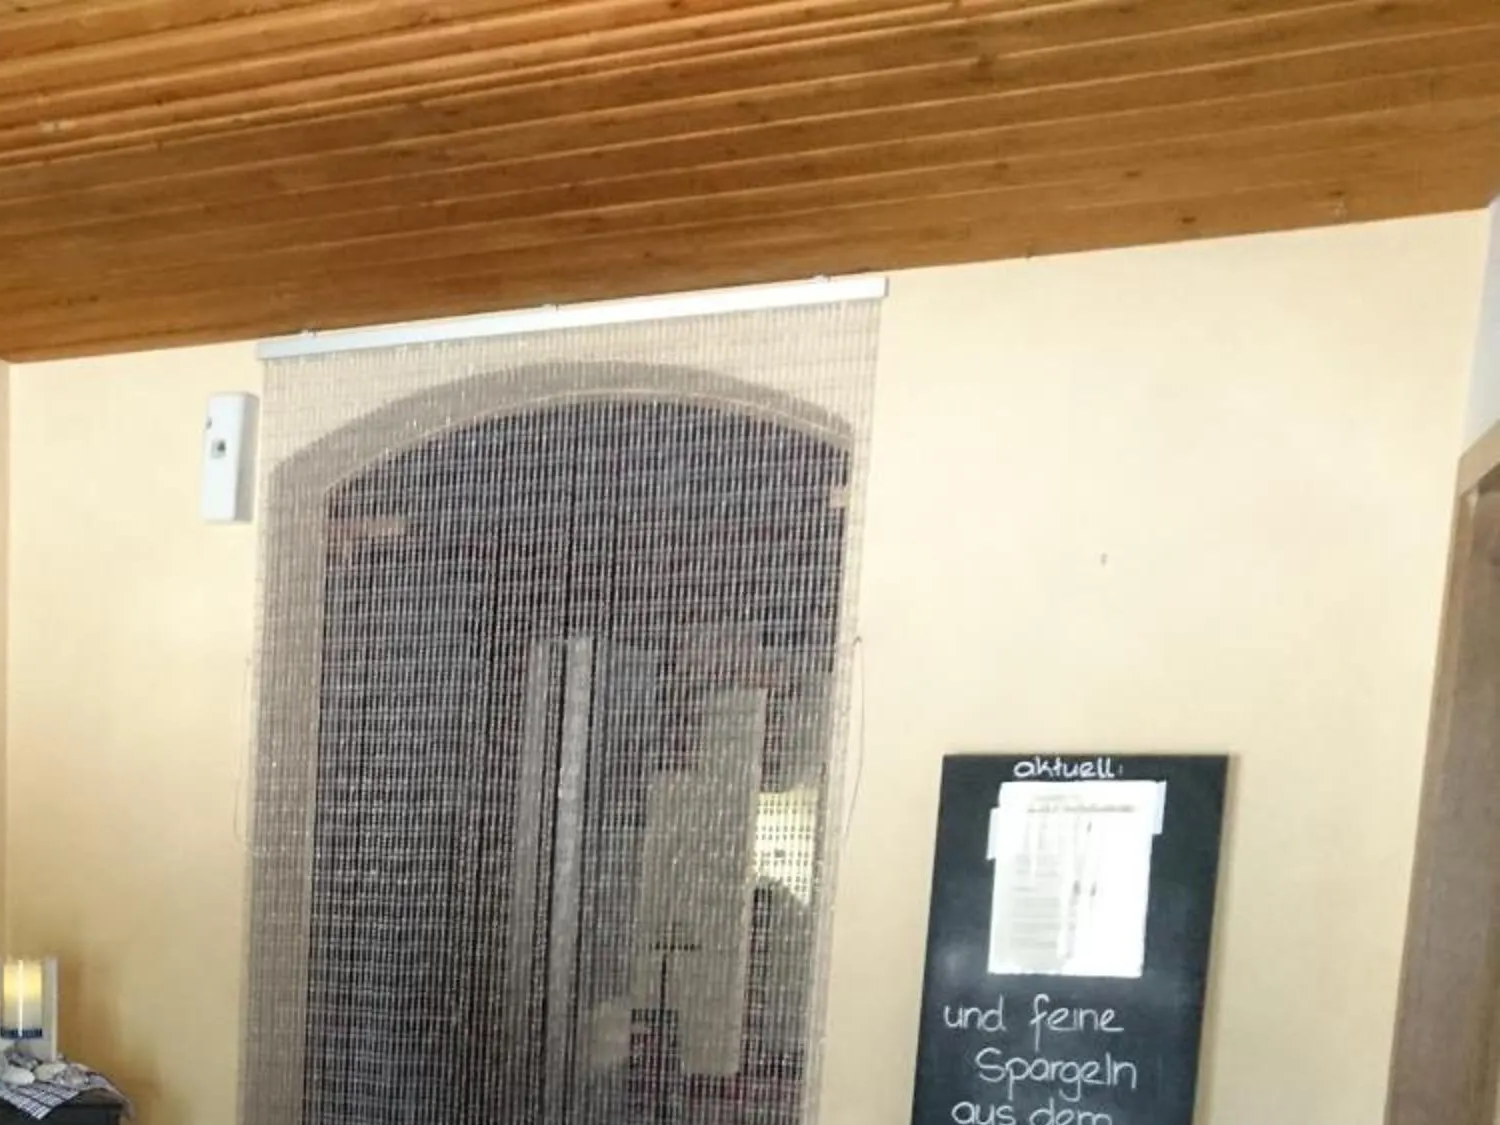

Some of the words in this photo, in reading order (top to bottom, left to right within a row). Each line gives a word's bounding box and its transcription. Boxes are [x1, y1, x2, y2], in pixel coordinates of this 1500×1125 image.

[943, 995, 1007, 1032] und
[1029, 993, 1124, 1051] feine
[975, 1047, 1137, 1102] Spargeln
